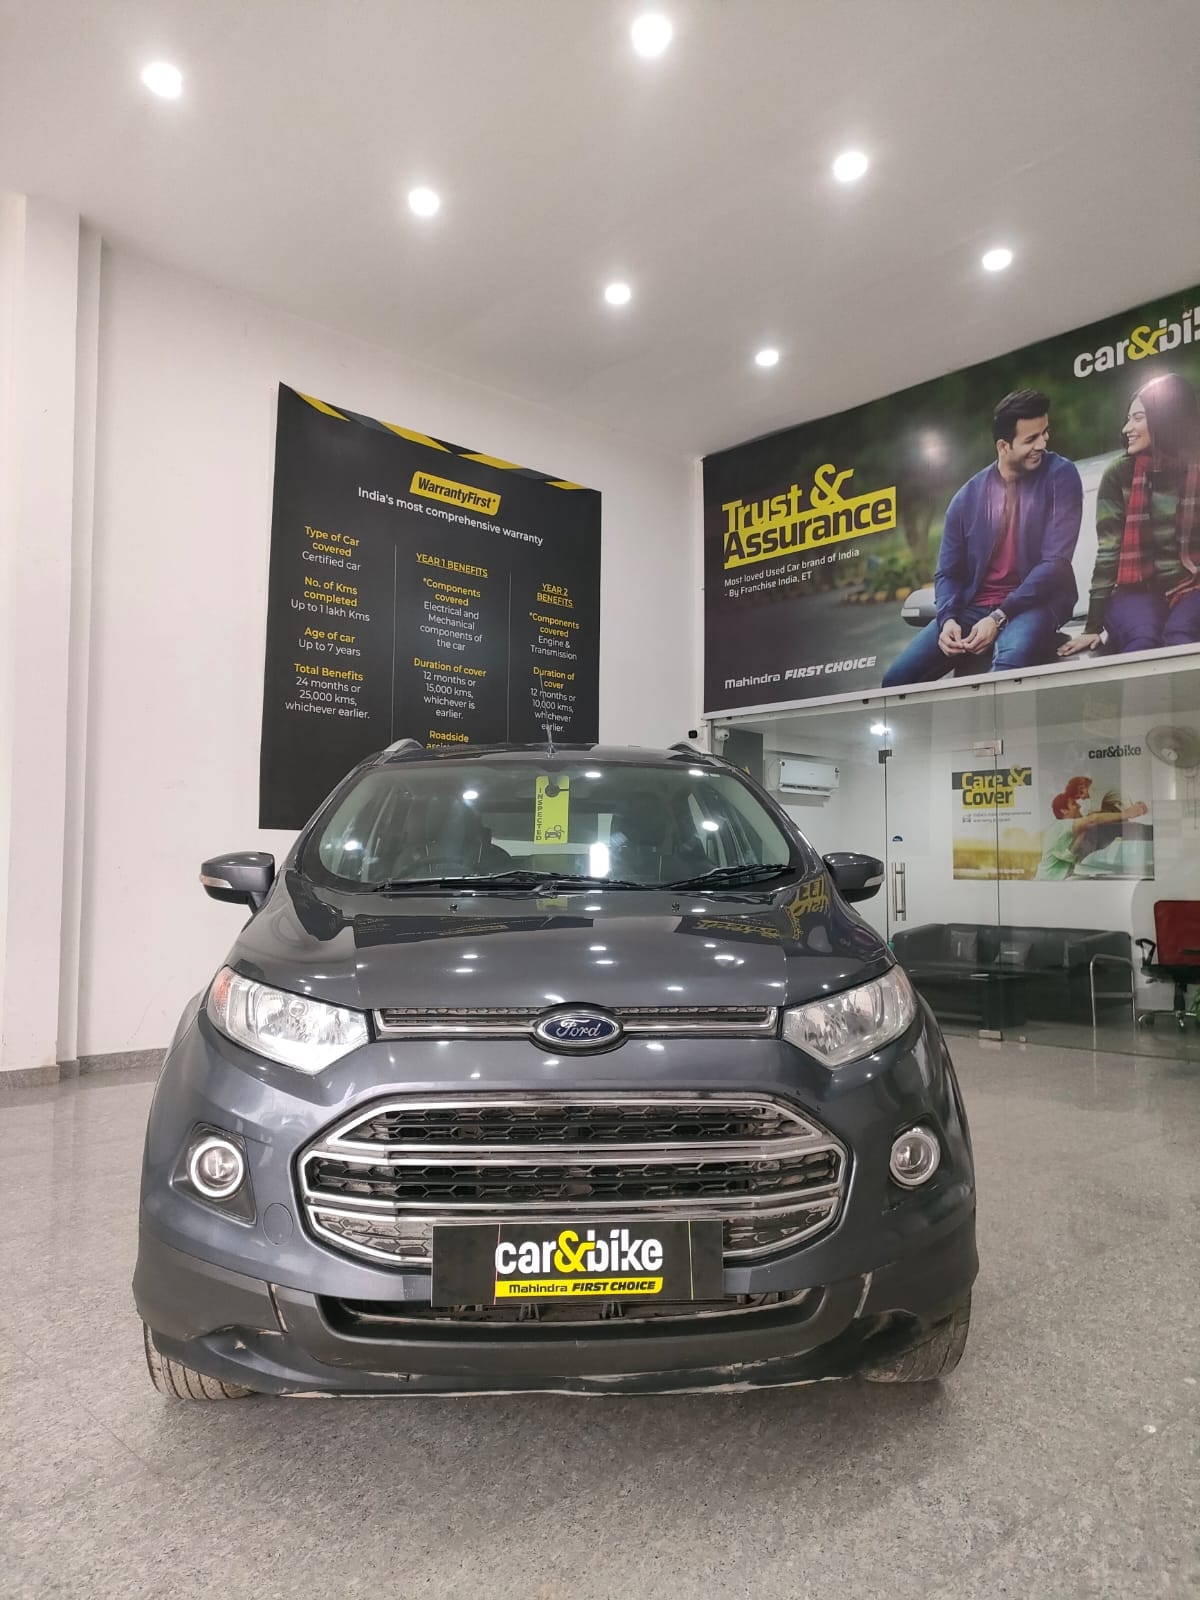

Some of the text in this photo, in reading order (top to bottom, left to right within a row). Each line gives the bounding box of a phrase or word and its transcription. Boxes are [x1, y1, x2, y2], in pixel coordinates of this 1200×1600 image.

[722, 463, 854, 533] Trust &
[358, 487, 544, 547] India's most comprehensive warranty
[304, 525, 360, 547] Type of Car
[723, 498, 892, 561] Assurance
[312, 542, 352, 557] covered
[302, 551, 361, 571] Certified car
[416, 552, 441, 567] YEAR
[447, 560, 488, 578] BENEFITS
[724, 548, 860, 588] Most loved Used Car brand of India
[304, 576, 358, 595] No. of Kms
[542, 583, 569, 597] YEAR 2
[729, 588, 739, 598] By
[740, 580, 777, 595] Franchise
[778, 575, 800, 588] India,
[801, 570, 813, 581] ET
[304, 590, 358, 607] completed
[435, 593, 469, 607] covered
[537, 592, 574, 608] BENEFITS
[291, 598, 371, 622] Up to 1 lakh Kms
[424, 600, 479, 620] Electrical and
[428, 613, 475, 630] Mechanical
[304, 627, 356, 644] Age of car
[419, 625, 483, 643] components of
[540, 626, 569, 638] covered
[298, 638, 361, 657] Up to 7 years
[436, 638, 466, 651] the car
[538, 635, 571, 649] Engine &
[530, 644, 578, 660] Transmission
[293, 663, 364, 681] Total Benefits
[414, 657, 488, 677] Duration of cover
[533, 666, 575, 681] Duration of
[724, 655, 877, 689] Mahindra FIRST CHOICE
[295, 676, 361, 694] 24 months or
[423, 670, 476, 687] 12 months or
[544, 680, 565, 690] cover
[299, 689, 358, 707] 25,000 kms,
[425, 682, 474, 699] 15,000 kms,
[530, 687, 538, 697] 12
[539, 689, 568, 701] months
[285, 700, 370, 719] whichever earlier.
[423, 694, 476, 710] whichever is
[435, 709, 464, 720] earlier.
[429, 730, 470, 743] Roadside
[1088, 745, 1142, 760] car&bike
[961, 764, 1032, 790] Care &
[962, 788, 1014, 806] Cover
[535, 787, 544, 841] INSPECTED
[556, 1018, 602, 1037] Ford
[495, 1228, 664, 1275] car&bike
[509, 1280, 656, 1294] Mahindra FIRST CHOICE
